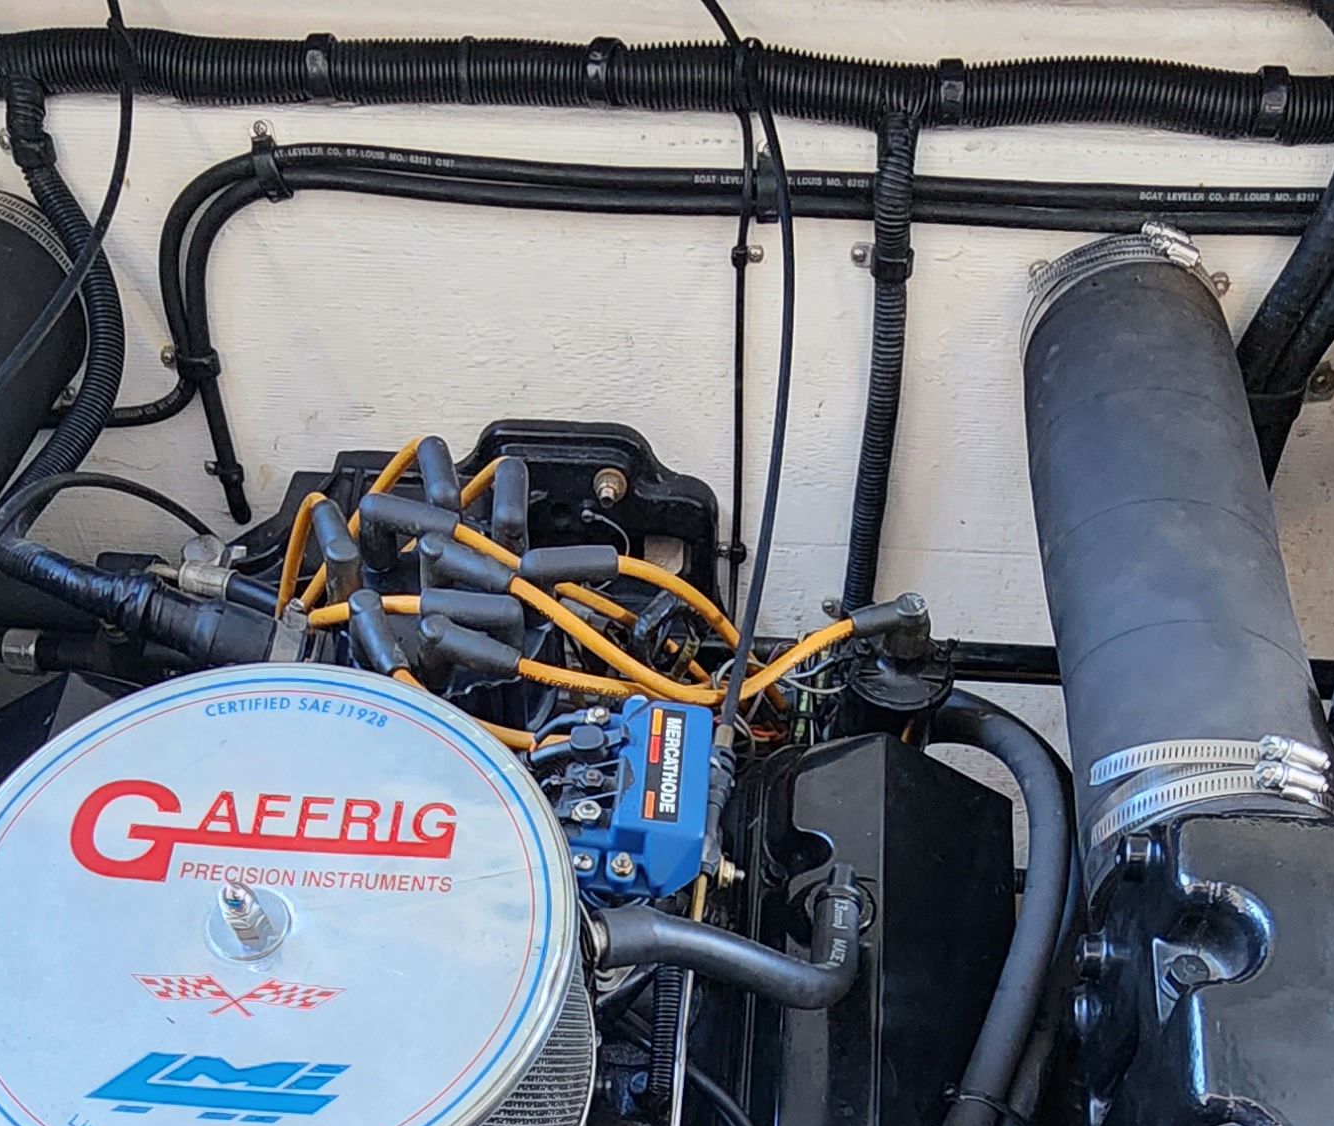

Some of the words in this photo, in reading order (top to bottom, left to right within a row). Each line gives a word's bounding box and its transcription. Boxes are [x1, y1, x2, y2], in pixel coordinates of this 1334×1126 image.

[694, 174, 717, 185] BOAT
[797, 177, 822, 187] LOUIS
[1167, 192, 1205, 202] LEVELER
[1244, 193, 1270, 202] LOUIS
[518, 671, 547, 685] ABLE
[205, 695, 291, 718] CERTIFIED
[297, 696, 334, 716] SAE
[336, 702, 387, 729] J1928
[659, 716, 683, 814] MERCATHODE
[69, 779, 458, 883] GAFFRIG
[179, 862, 296, 887] PRECISION
[301, 869, 452, 895] INSTRUMENTS
